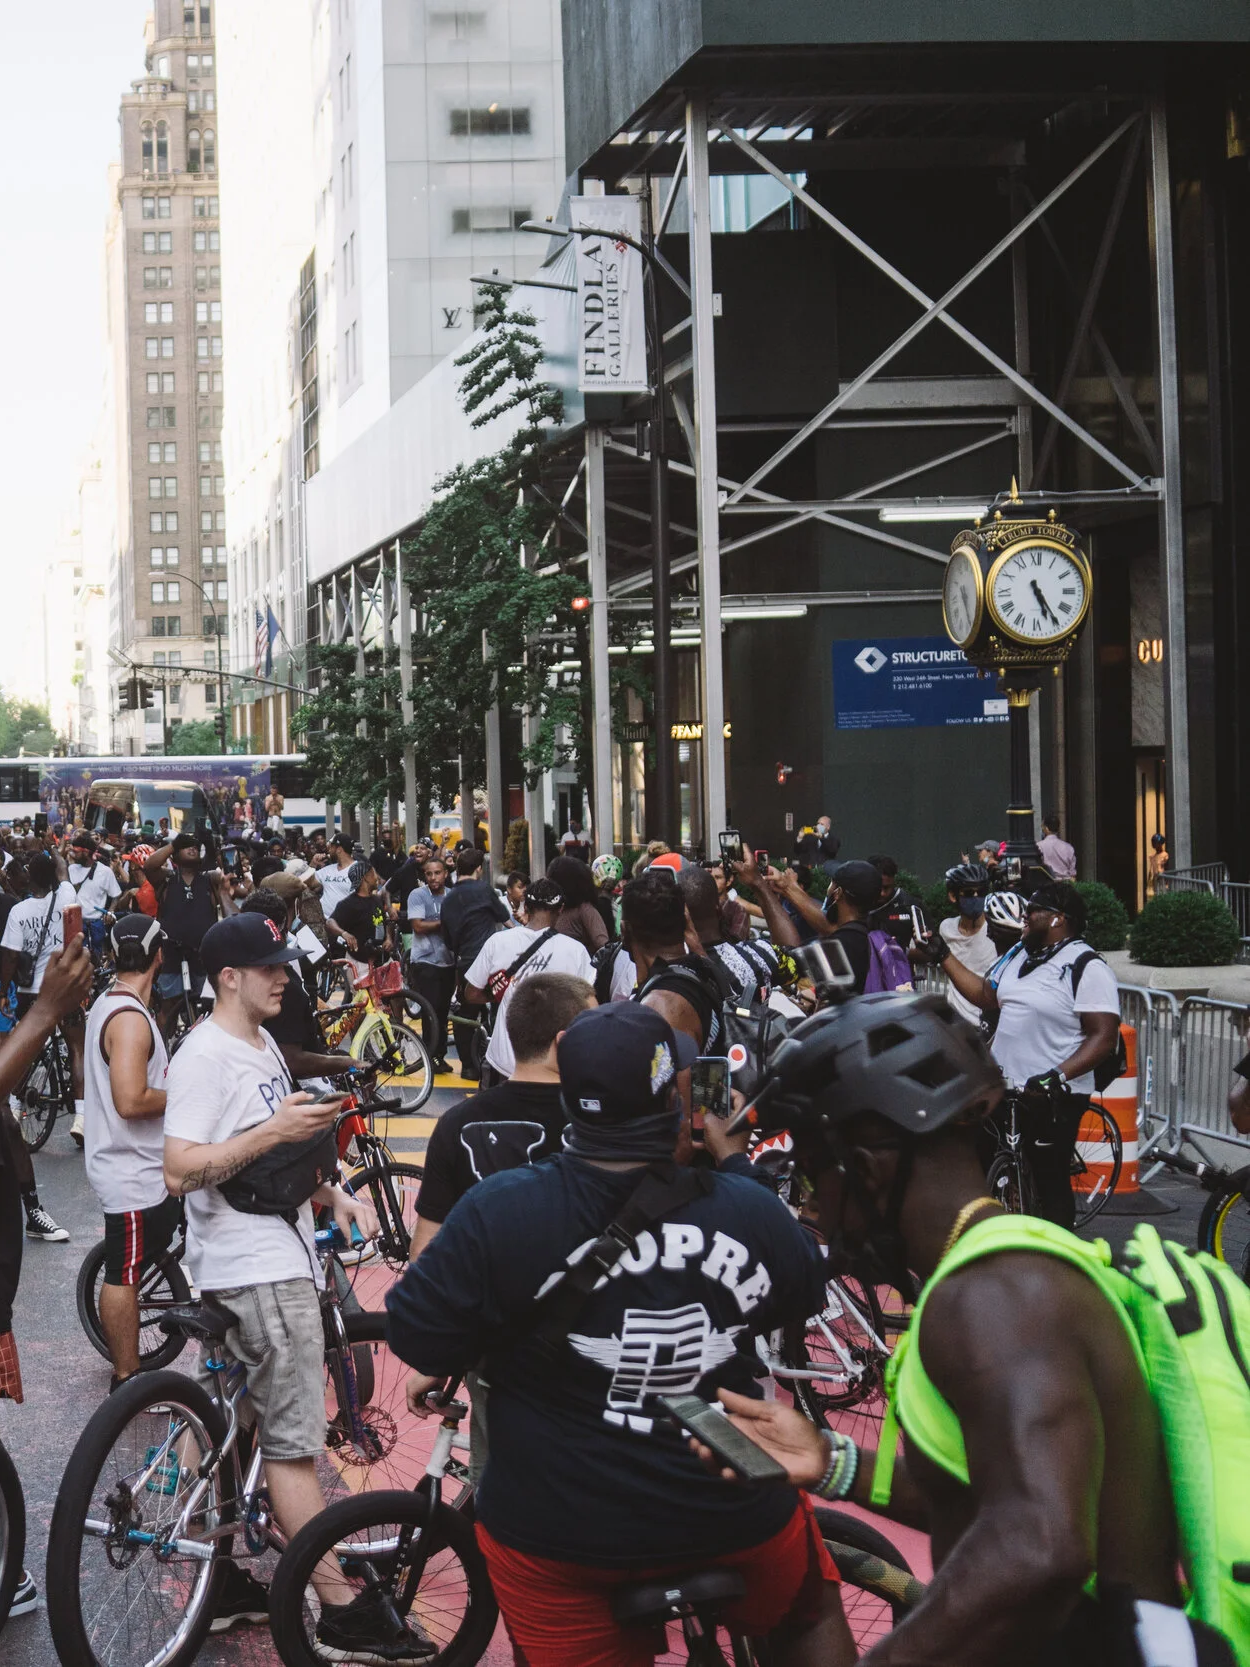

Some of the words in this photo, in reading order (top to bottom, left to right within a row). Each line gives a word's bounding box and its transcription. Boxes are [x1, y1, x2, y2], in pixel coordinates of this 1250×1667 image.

[605, 262, 622, 378] GALLERIES
[1002, 526, 1034, 543] TRUMP
[1037, 526, 1068, 543] TOWER
[324, 875, 346, 883] BLACK
[258, 1074, 293, 1116] PO
